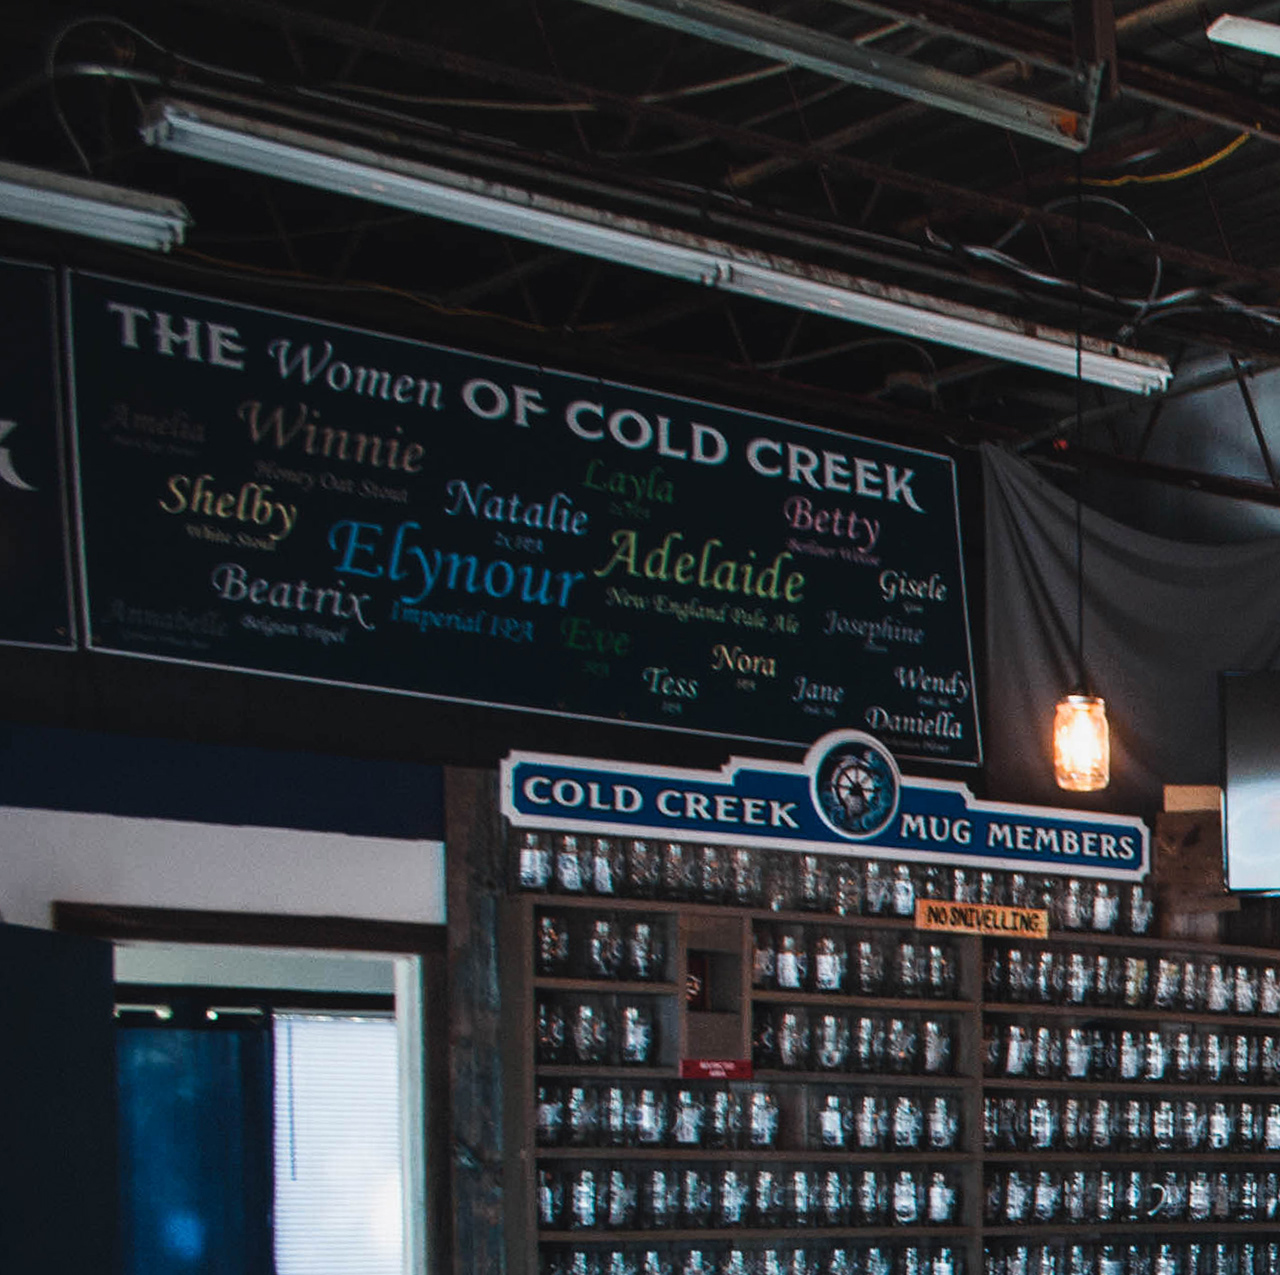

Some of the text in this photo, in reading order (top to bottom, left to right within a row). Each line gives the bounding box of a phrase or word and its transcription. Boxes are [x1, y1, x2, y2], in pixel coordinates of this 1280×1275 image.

[108, 302, 926, 514] THE Women OF COLD CREEK
[237, 399, 425, 474] Winnie
[580, 458, 675, 504] Layla
[158, 473, 297, 540] Shelby
[444, 479, 589, 536] Natalie
[784, 495, 880, 553] Betty
[328, 519, 586, 608] Elynour
[593, 528, 806, 604] Adelaide
[879, 568, 949, 604] Gisele
[211, 562, 376, 632] Beatrix
[560, 615, 632, 657] Eve
[822, 609, 925, 645] Josephine
[641, 666, 700, 700] Tess
[710, 643, 779, 679] Nora
[893, 665, 970, 704] Wendy
[791, 675, 847, 704] Jane
[864, 704, 964, 741] Daniella
[522, 775, 801, 829] COLD CREEK
[900, 813, 1135, 861] MUG MEMBERS
[927, 905, 947, 926] NO
